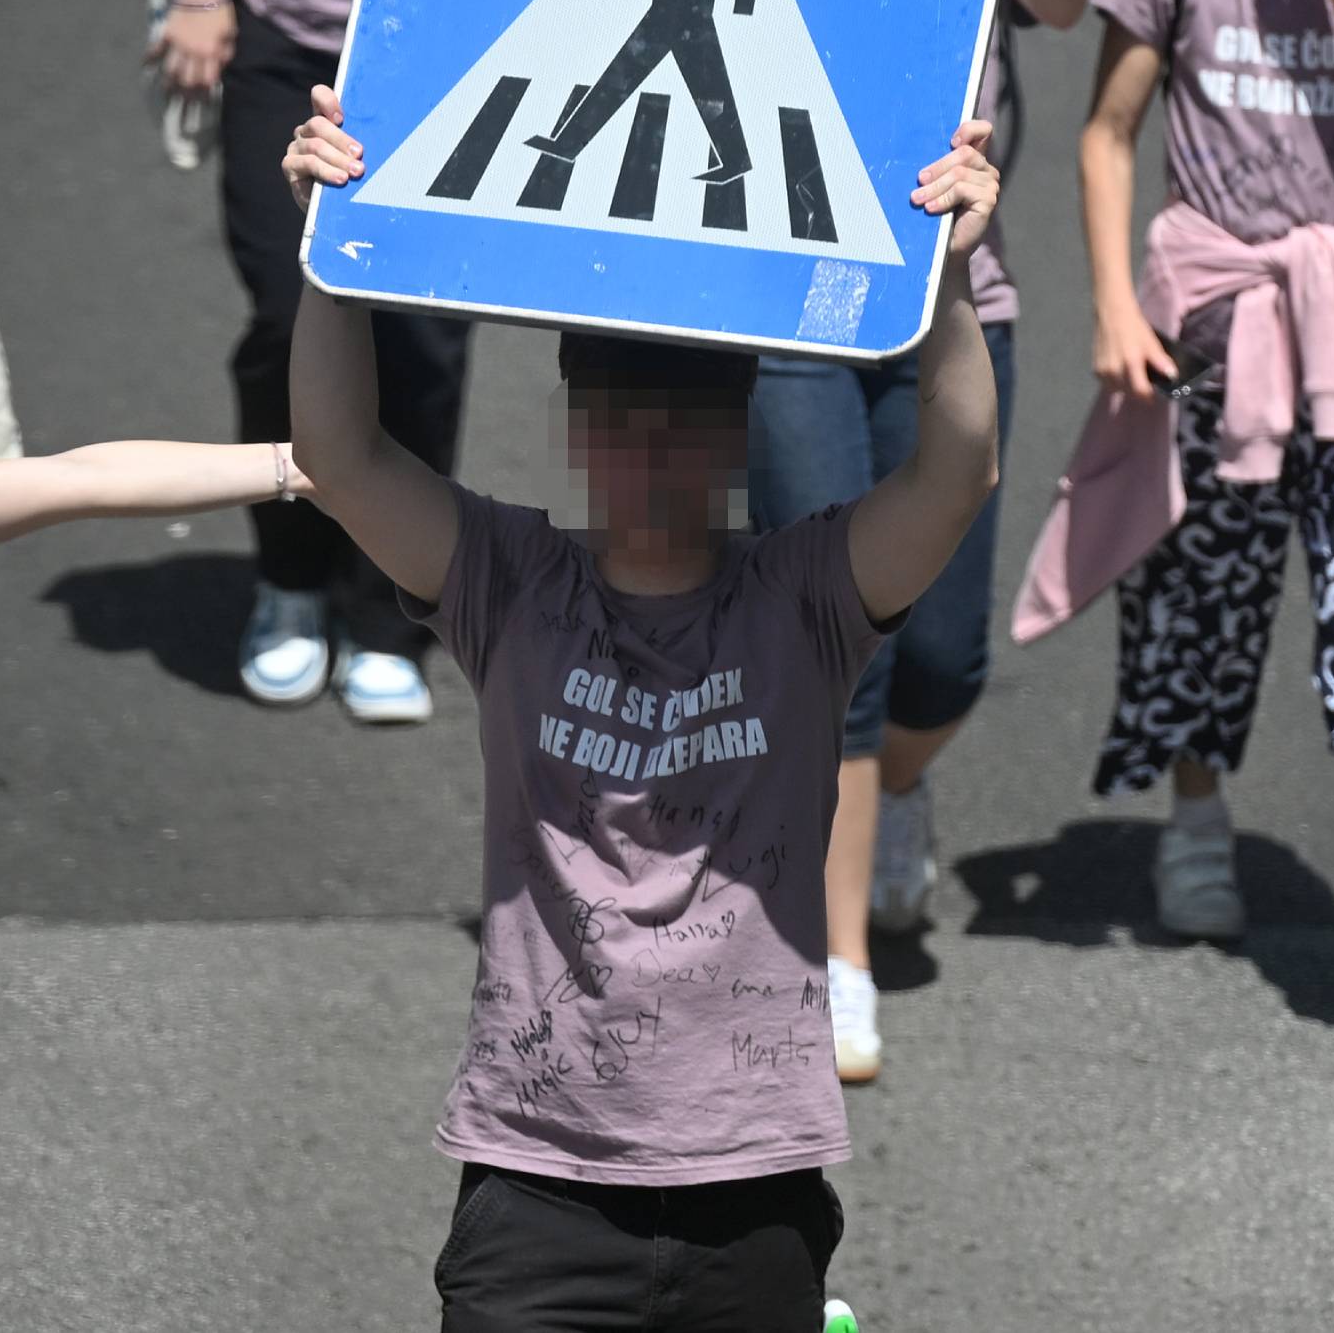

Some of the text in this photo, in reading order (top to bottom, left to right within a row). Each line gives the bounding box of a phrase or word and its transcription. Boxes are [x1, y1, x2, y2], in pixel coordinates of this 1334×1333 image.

[563, 667, 617, 716] GOL
[620, 685, 657, 730] SE
[538, 713, 575, 759] NE
[571, 727, 642, 782] BOJI
[515, 1052, 575, 1119] MAGIC
